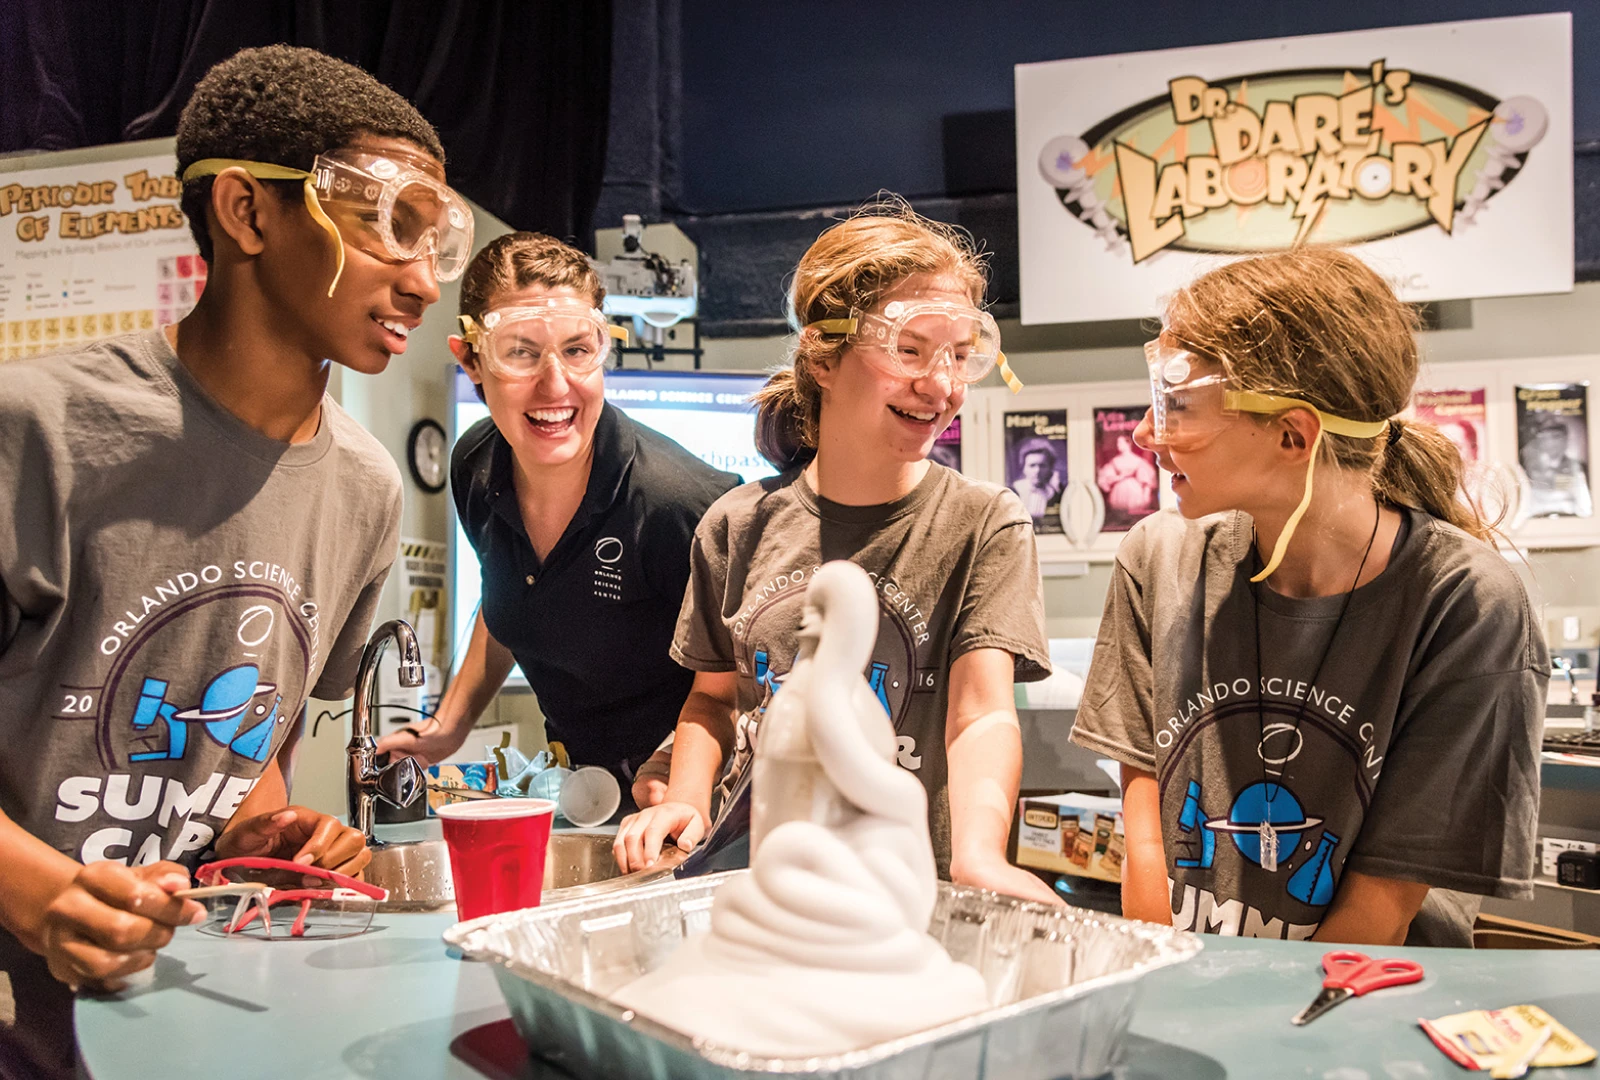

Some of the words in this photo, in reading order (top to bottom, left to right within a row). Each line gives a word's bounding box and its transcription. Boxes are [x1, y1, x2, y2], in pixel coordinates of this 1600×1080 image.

[0, 180, 118, 218] PERIODIC
[123, 168, 183, 202] TAB
[1113, 113, 1495, 265] LABORATORY
[16, 215, 50, 243] OF
[59, 204, 184, 239] ELEMENTS
[604, 388, 657, 401] RLANDO
[100, 564, 223, 656] ORLANDO
[233, 560, 302, 601] SCIENCE
[734, 569, 805, 636] ORLANDO
[883, 582, 931, 646] CENTER
[61, 694, 94, 713] 20
[918, 672, 935, 687] 16
[1155, 677, 1251, 749] ORLANDO
[1260, 676, 1356, 725] SCIENCE
